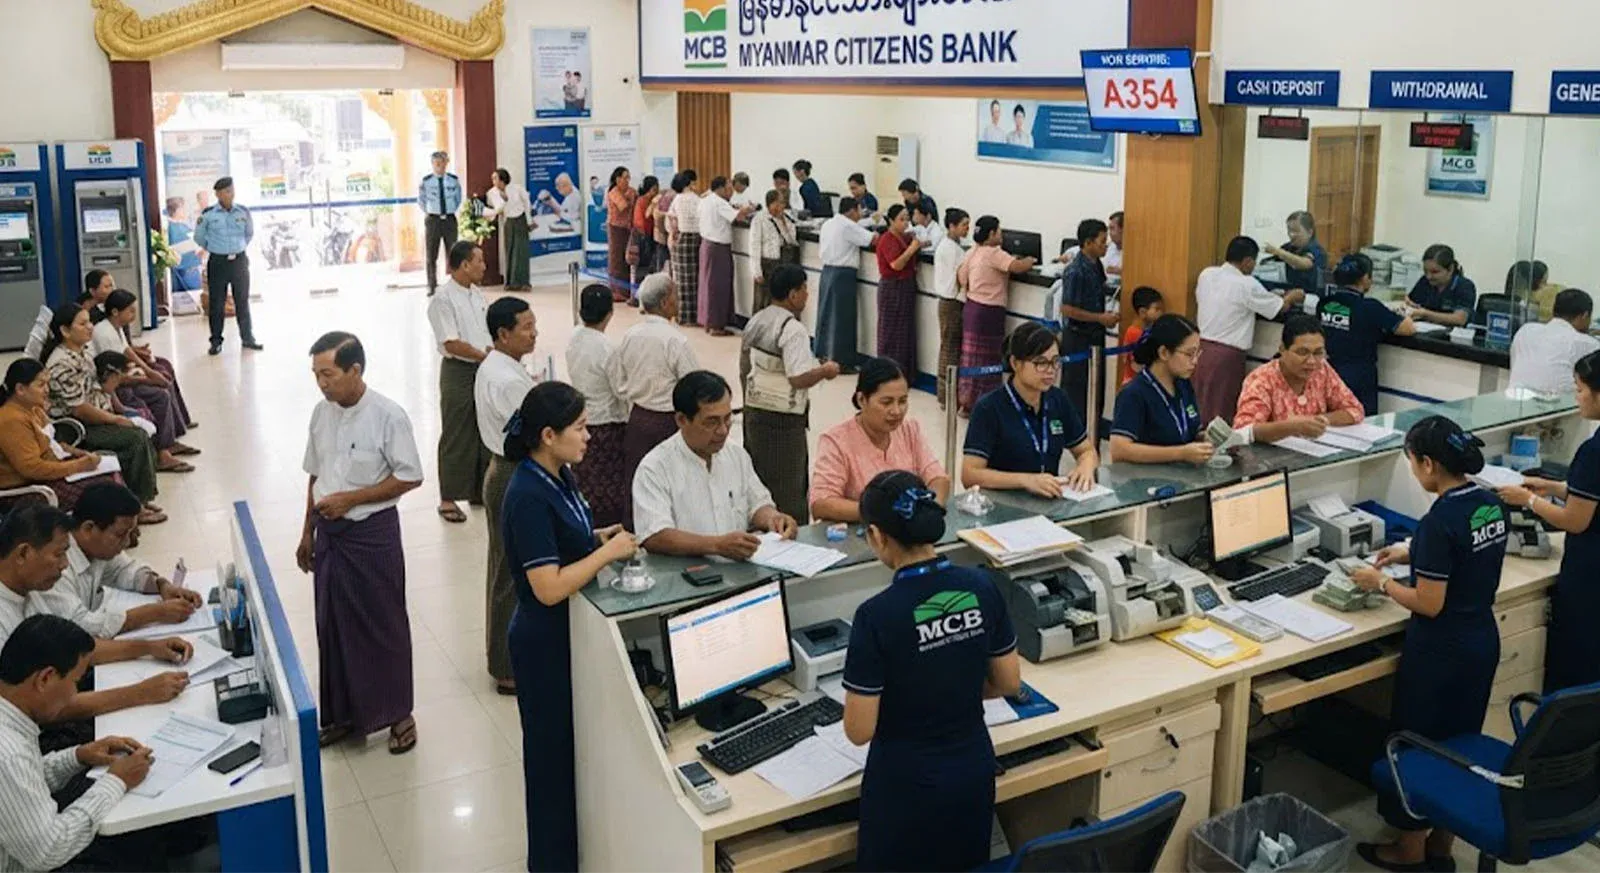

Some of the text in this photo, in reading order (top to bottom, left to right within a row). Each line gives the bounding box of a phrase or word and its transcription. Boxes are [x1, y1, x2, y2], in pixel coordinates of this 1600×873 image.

[684, 35, 727, 60] MCB
[739, 29, 1018, 67] MYANMAR CITIZENS BANK
[1104, 78, 1178, 110] A354
[1237, 80, 1325, 96] CASH DEPOSIT
[1391, 81, 1488, 99] WITHDRAWAL
[1441, 157, 1475, 169] MCB
[916, 609, 983, 643] MCB
